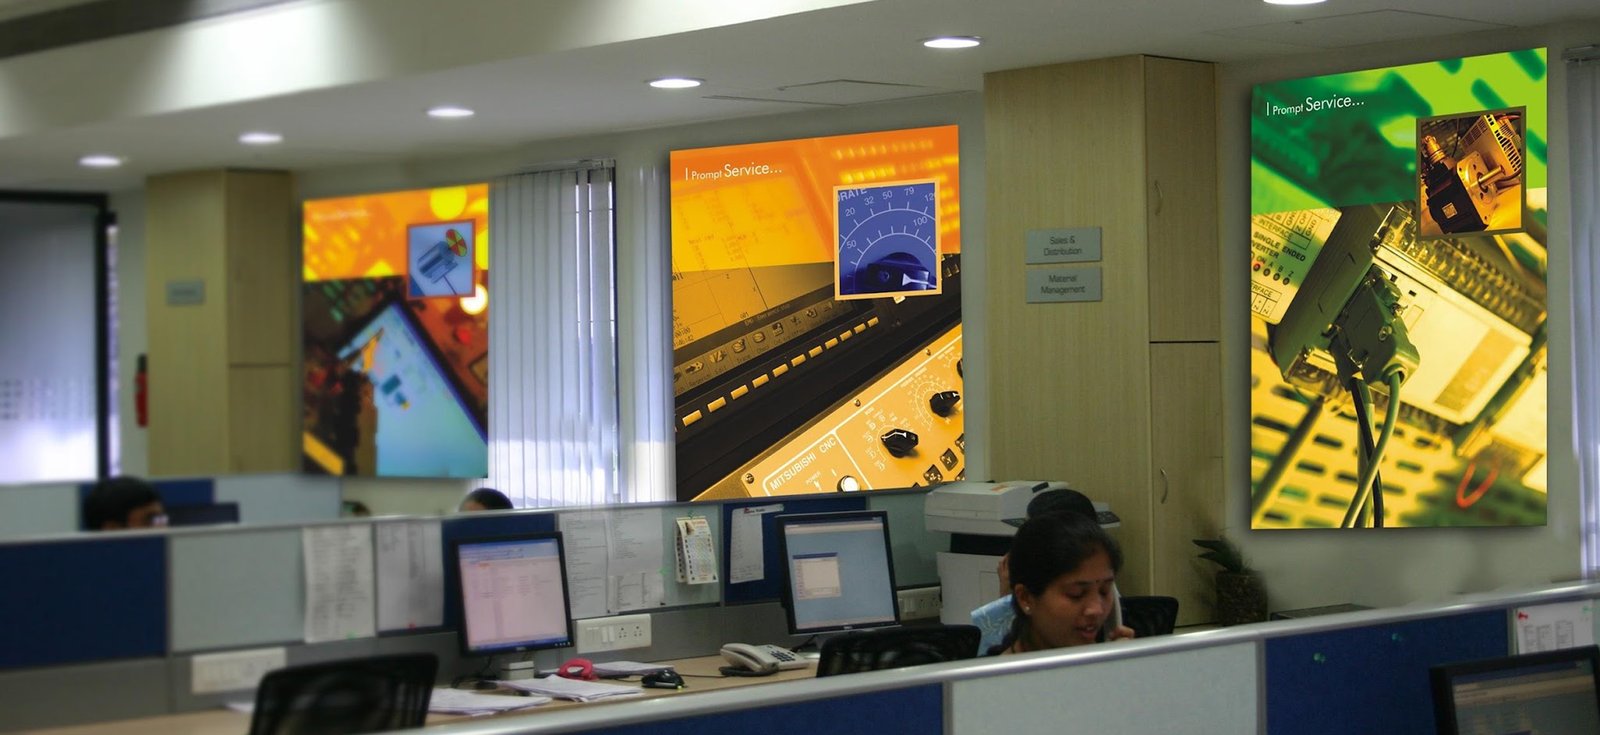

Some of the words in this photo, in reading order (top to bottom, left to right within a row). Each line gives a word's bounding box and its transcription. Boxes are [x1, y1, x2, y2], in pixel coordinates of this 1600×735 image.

[1272, 103, 1304, 116] Prompt
[1305, 94, 1365, 112] Service...
[691, 170, 723, 181] Prompt
[724, 162, 782, 178] Service...
[845, 207, 856, 217] 20
[864, 196, 875, 206] 32
[882, 190, 893, 200] 50
[904, 186, 915, 196] 79
[846, 239, 857, 249] 50
[913, 216, 928, 227] 100
[1258, 218, 1293, 241] INTERFACE
[1253, 231, 1281, 249] SINGLE
[1282, 246, 1306, 262] ENDED
[769, 452, 818, 491] MITSUBISHI
[819, 437, 837, 454] CNC
